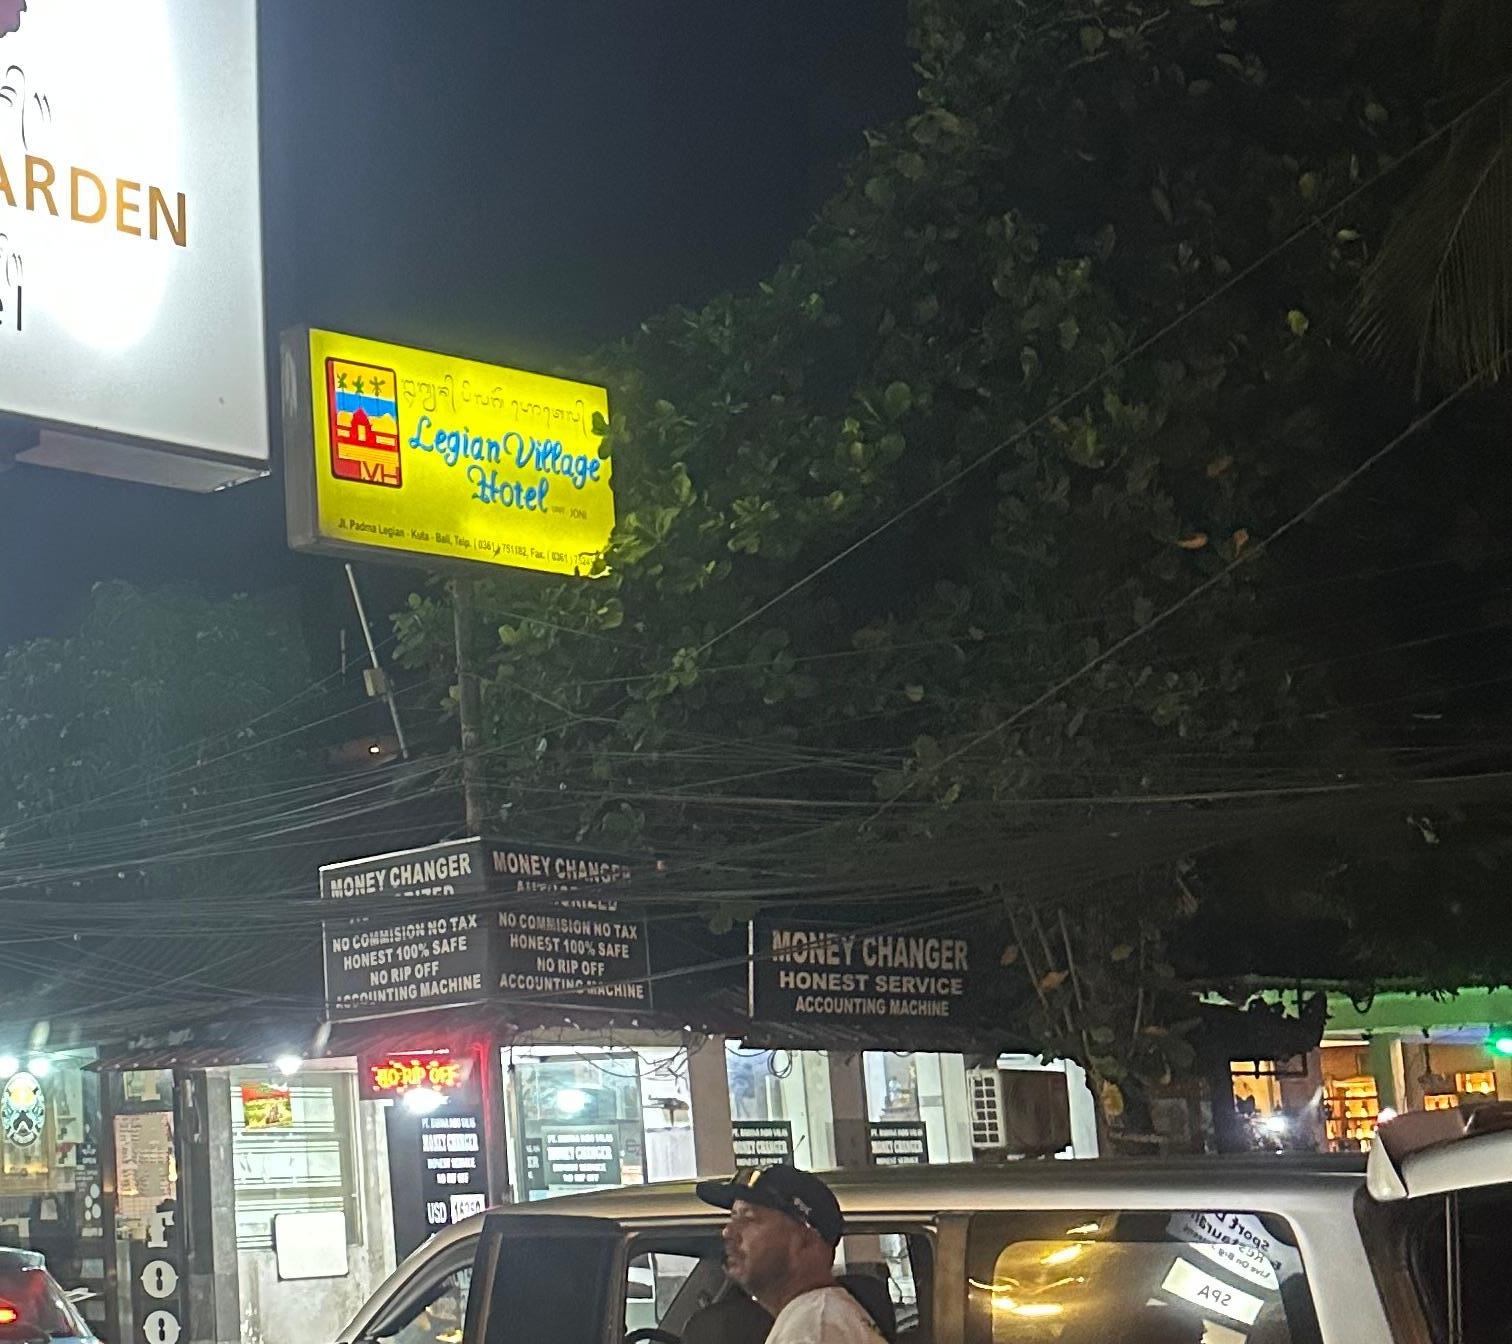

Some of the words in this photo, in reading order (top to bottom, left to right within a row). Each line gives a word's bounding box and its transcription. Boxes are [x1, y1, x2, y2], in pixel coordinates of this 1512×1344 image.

[408, 415, 501, 467] Legian
[503, 431, 601, 490] Village
[467, 464, 550, 513] Hotel
[378, 524, 405, 539] Legian
[411, 529, 429, 542] Kuta
[331, 869, 387, 899] MONEY
[389, 853, 472, 889] CHANGER
[493, 851, 550, 877] MONEY
[333, 937, 350, 953] NO
[427, 919, 447, 936] NO
[449, 913, 478, 932] TAX
[498, 912, 516, 929] NO
[593, 921, 611, 937] NO
[612, 922, 638, 940] TAX
[343, 947, 393, 971] HONEST
[396, 941, 429, 962] 100%
[431, 935, 468, 956] SAFE
[510, 934, 561, 953] HONEST
[563, 938, 595, 956] 100%
[597, 941, 630, 958] SAFE
[772, 929, 857, 965] MONEY
[862, 935, 968, 972] CHANGER
[369, 971, 389, 986] NO
[390, 967, 412, 984] RIP
[414, 961, 440, 980] OFF
[537, 957, 555, 972] NO
[558, 959, 580, 975] RIP
[581, 961, 606, 976] OFF
[420, 974, 481, 998] MACHINE
[779, 971, 869, 992] HONEST
[875, 975, 963, 995] SERVICE
[795, 996, 886, 1015] ACCOUNTING
[889, 999, 950, 1016] MACHINE
